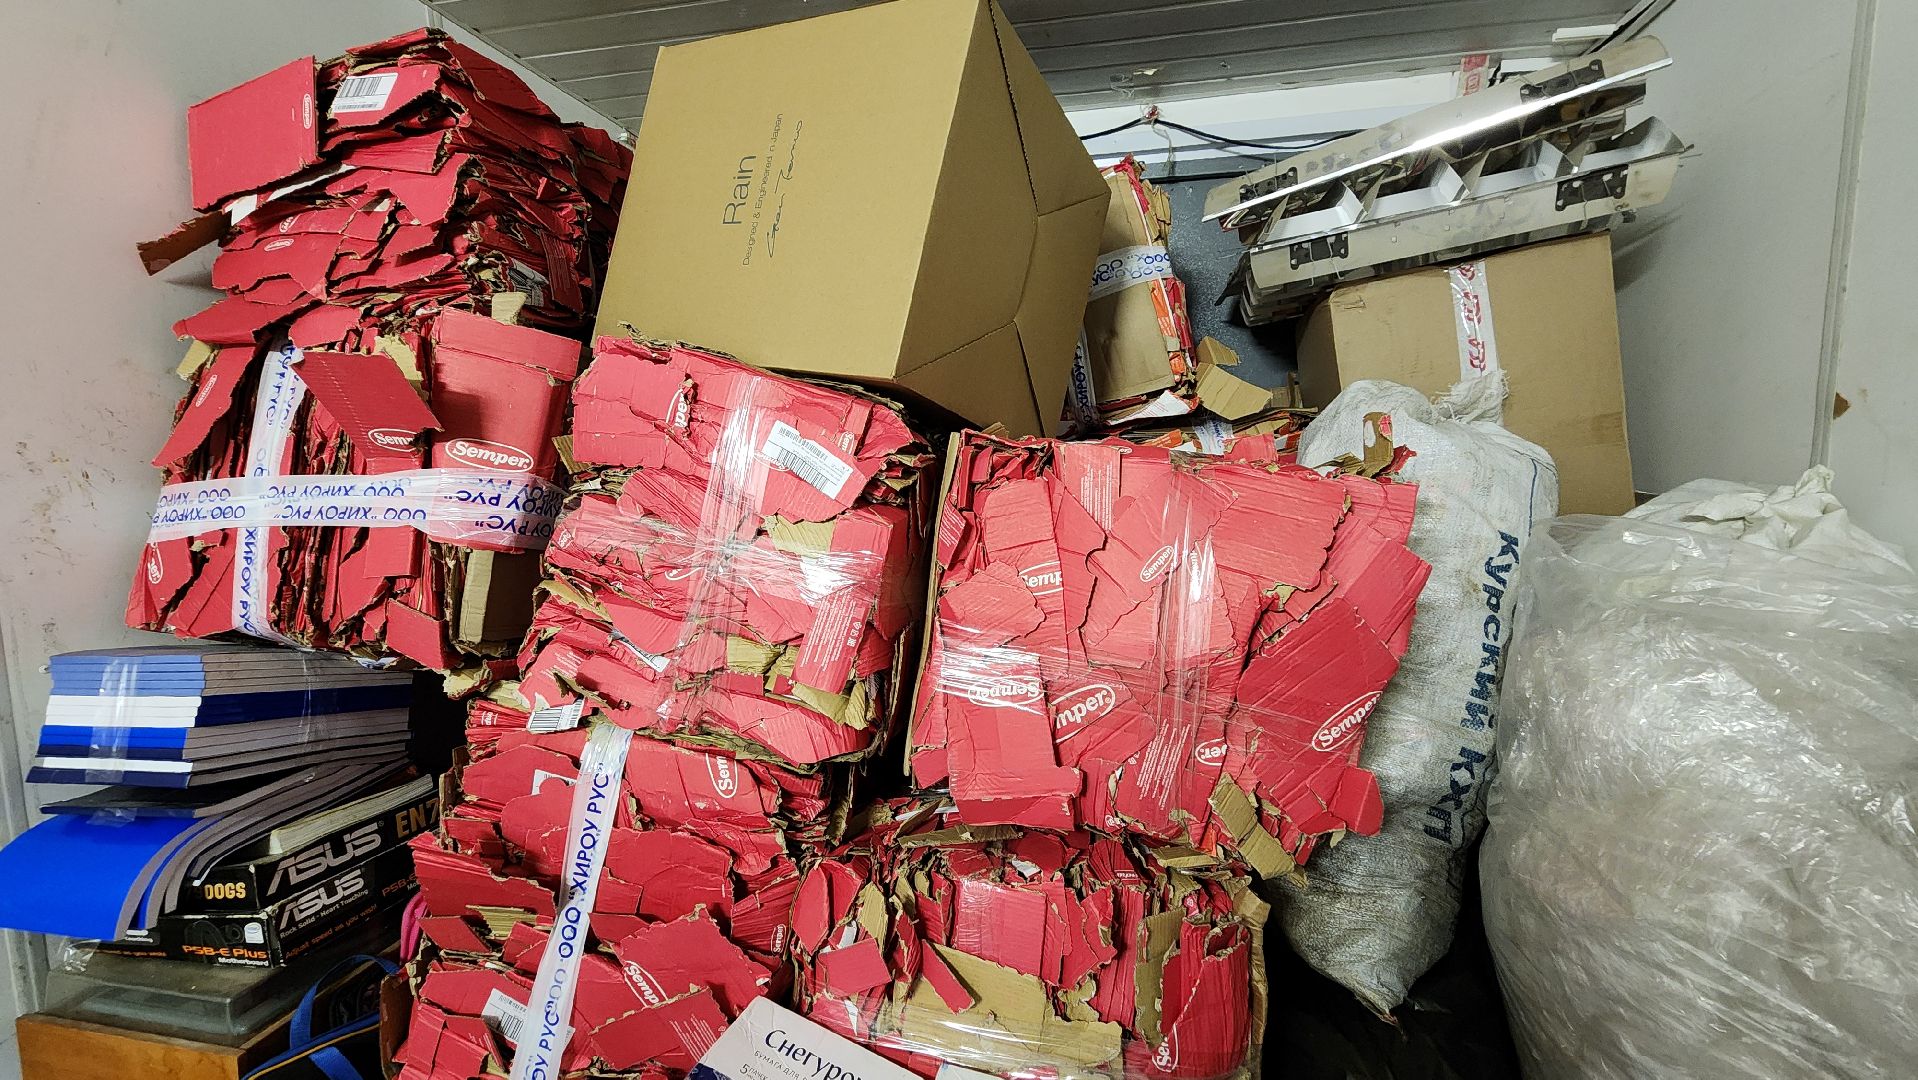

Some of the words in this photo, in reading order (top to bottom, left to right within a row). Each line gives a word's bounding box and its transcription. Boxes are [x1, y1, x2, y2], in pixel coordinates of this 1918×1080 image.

[771, 113, 783, 143] Japan
[722, 155, 757, 225] Rain
[755, 156, 773, 209] Engineered
[753, 211, 760, 219] &
[742, 221, 759, 266] Designed
[267, 822, 383, 897] ASUS
[279, 925, 298, 940] Rock
[298, 917, 316, 931] Solid
[320, 902, 340, 919] Heart
[339, 888, 369, 909] Touching
[280, 868, 366, 931] ASUS
[233, 946, 268, 960] Plus
[556, 906, 582, 961] ООО
[217, 956, 270, 968] Motherboard
[740, 1063, 750, 1075] 5
[754, 1050, 783, 1070] БУМАГА
[765, 1029, 862, 1080] Снегуро
